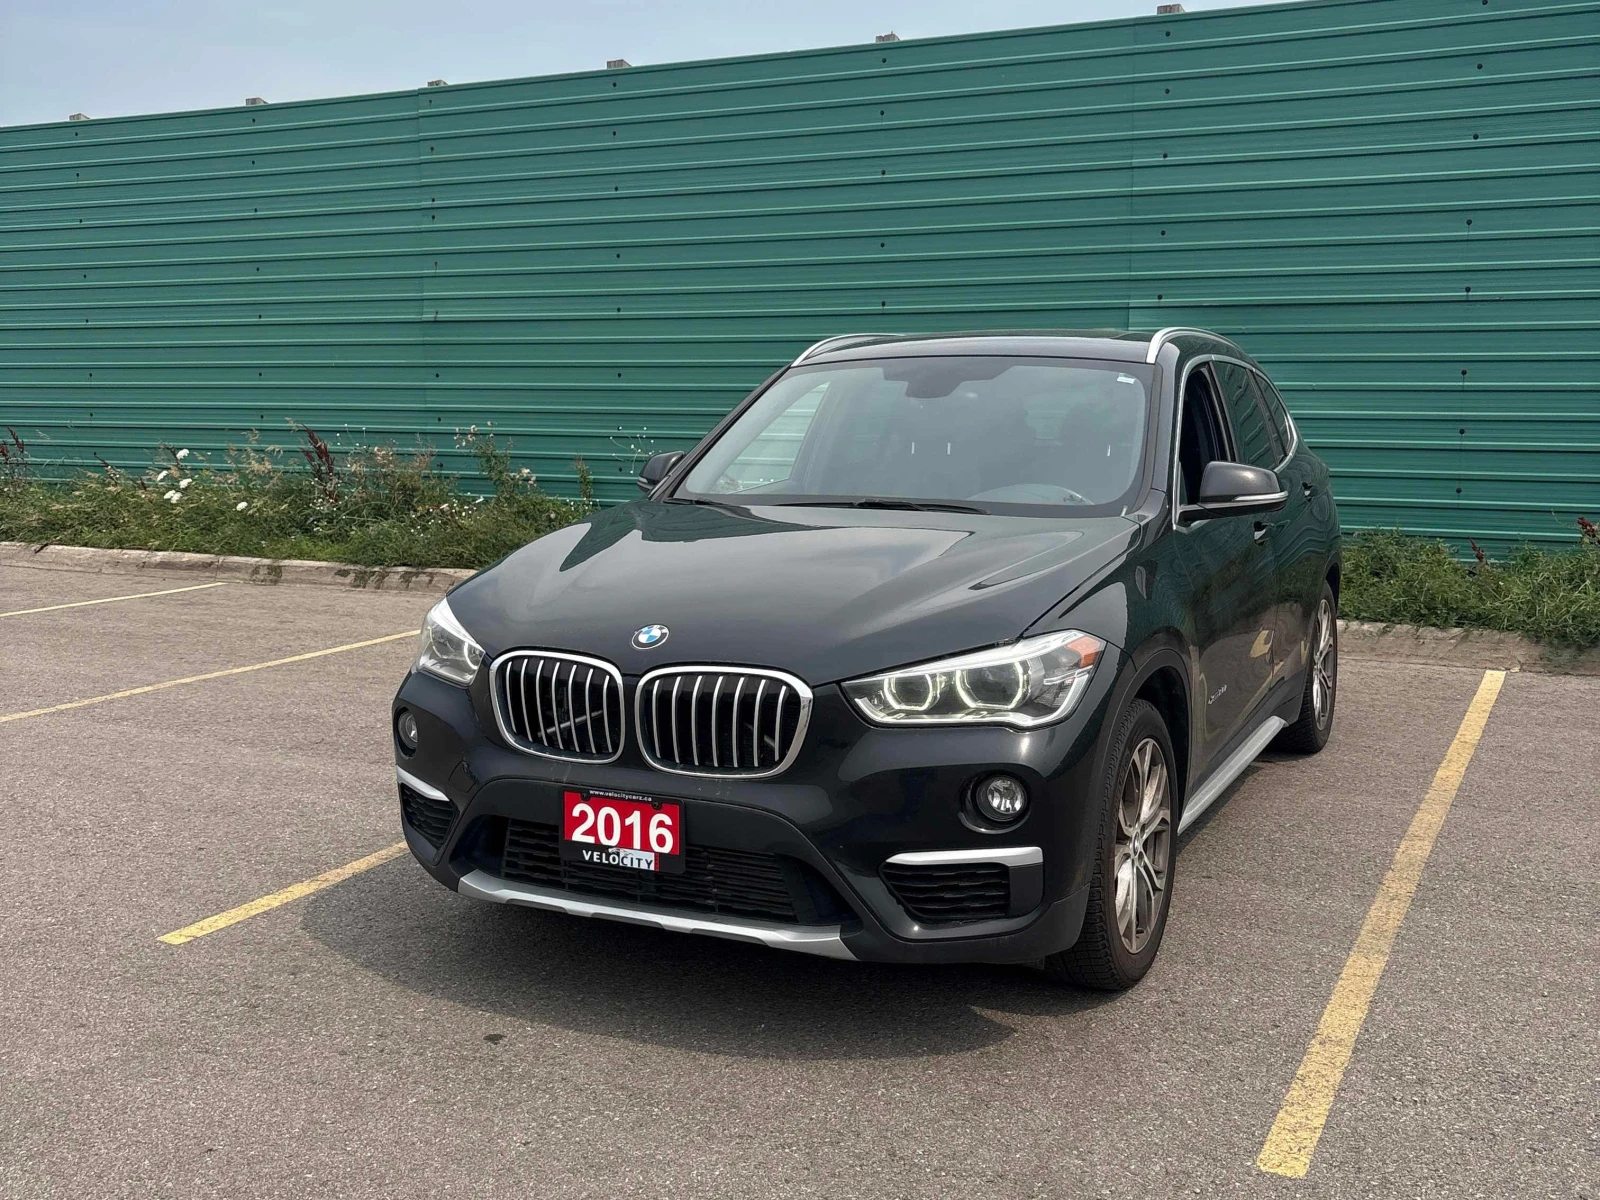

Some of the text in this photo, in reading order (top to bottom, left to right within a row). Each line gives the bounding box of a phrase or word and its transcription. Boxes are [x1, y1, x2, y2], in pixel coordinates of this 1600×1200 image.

[589, 789, 652, 802] www.velocitycarz.ca
[571, 803, 674, 854] 2016
[582, 849, 654, 870] VELOCITY
